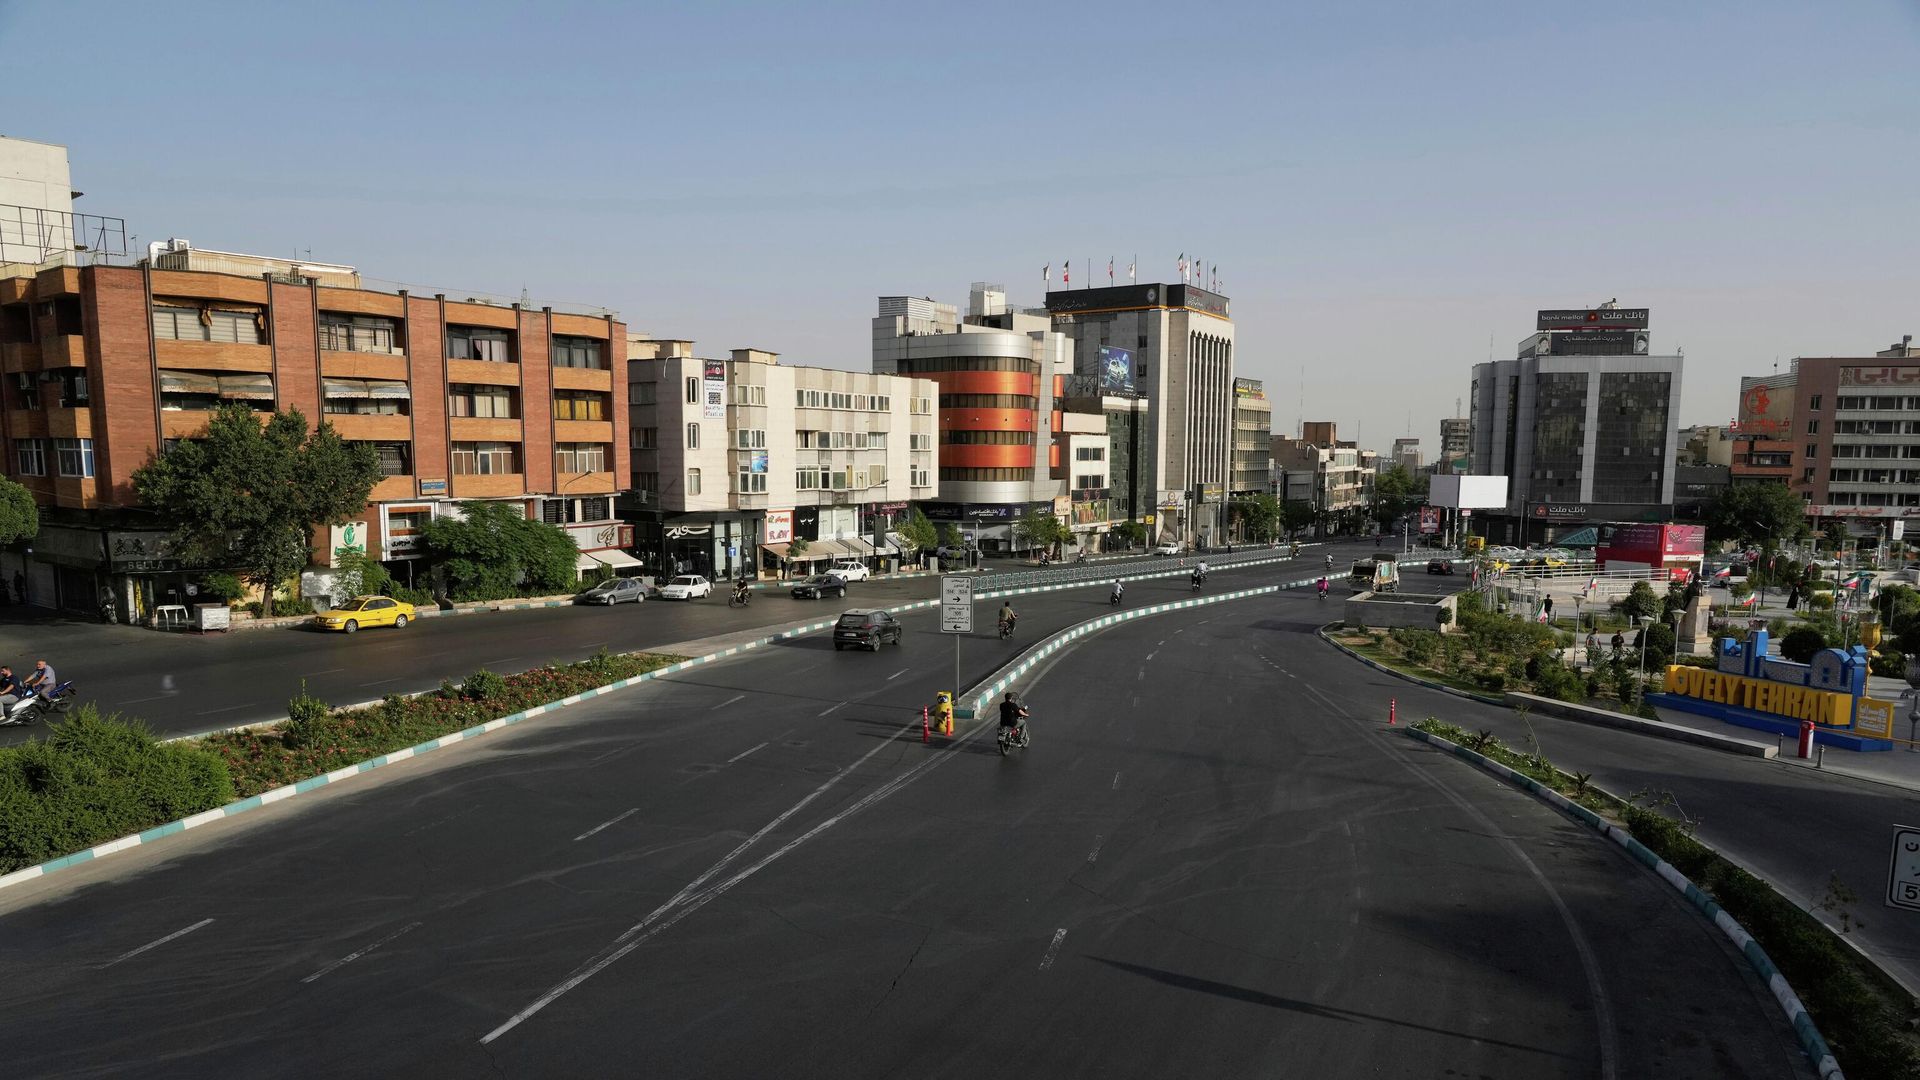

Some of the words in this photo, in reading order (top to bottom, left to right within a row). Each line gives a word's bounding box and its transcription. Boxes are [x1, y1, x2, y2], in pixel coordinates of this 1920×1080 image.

[1602, 312, 1623, 320] ملت
[127, 561, 165, 570] BELLA
[1664, 664, 1741, 706] LOVELY
[1742, 680, 1837, 725] TEHRAN
